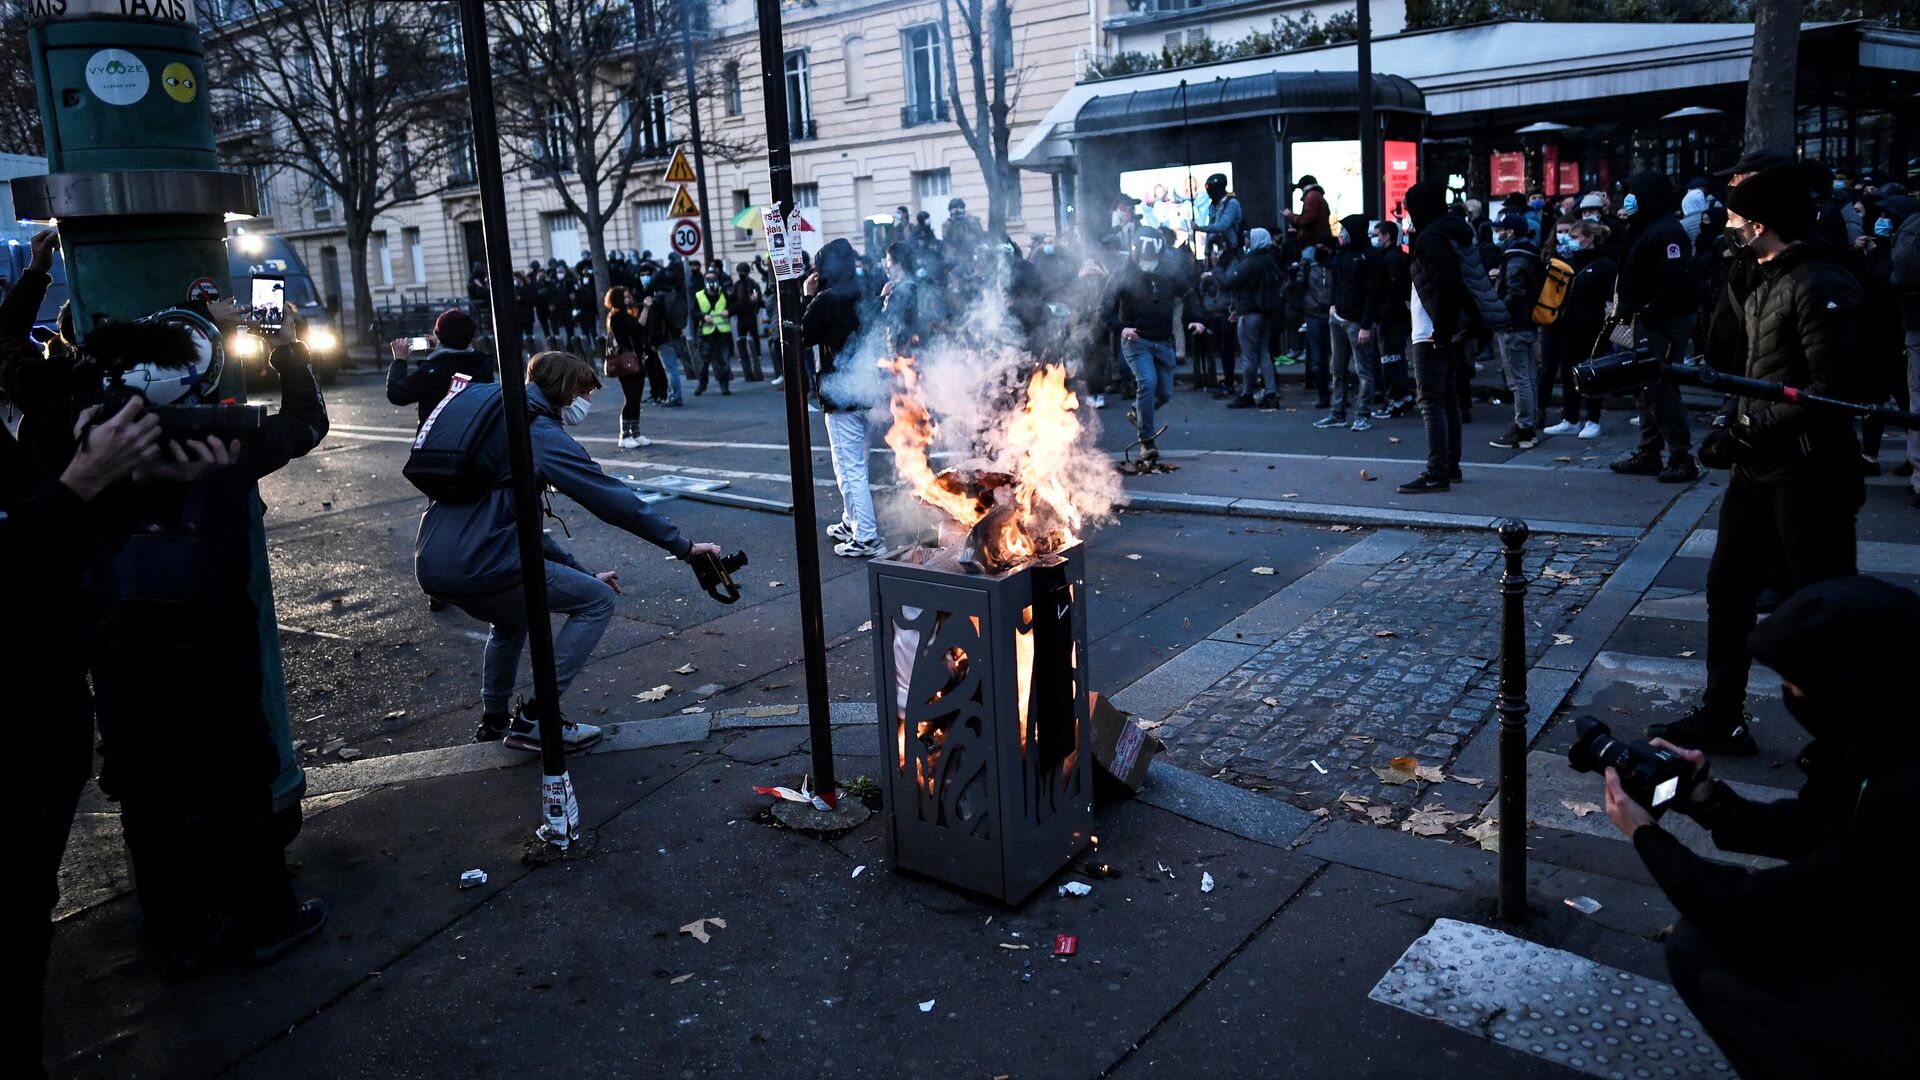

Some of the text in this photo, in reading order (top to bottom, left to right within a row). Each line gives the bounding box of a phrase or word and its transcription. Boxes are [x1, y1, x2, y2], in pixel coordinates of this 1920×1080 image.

[88, 61, 144, 75] VYOOZE
[677, 229, 696, 246] 30
[1139, 235, 1163, 254] TV
